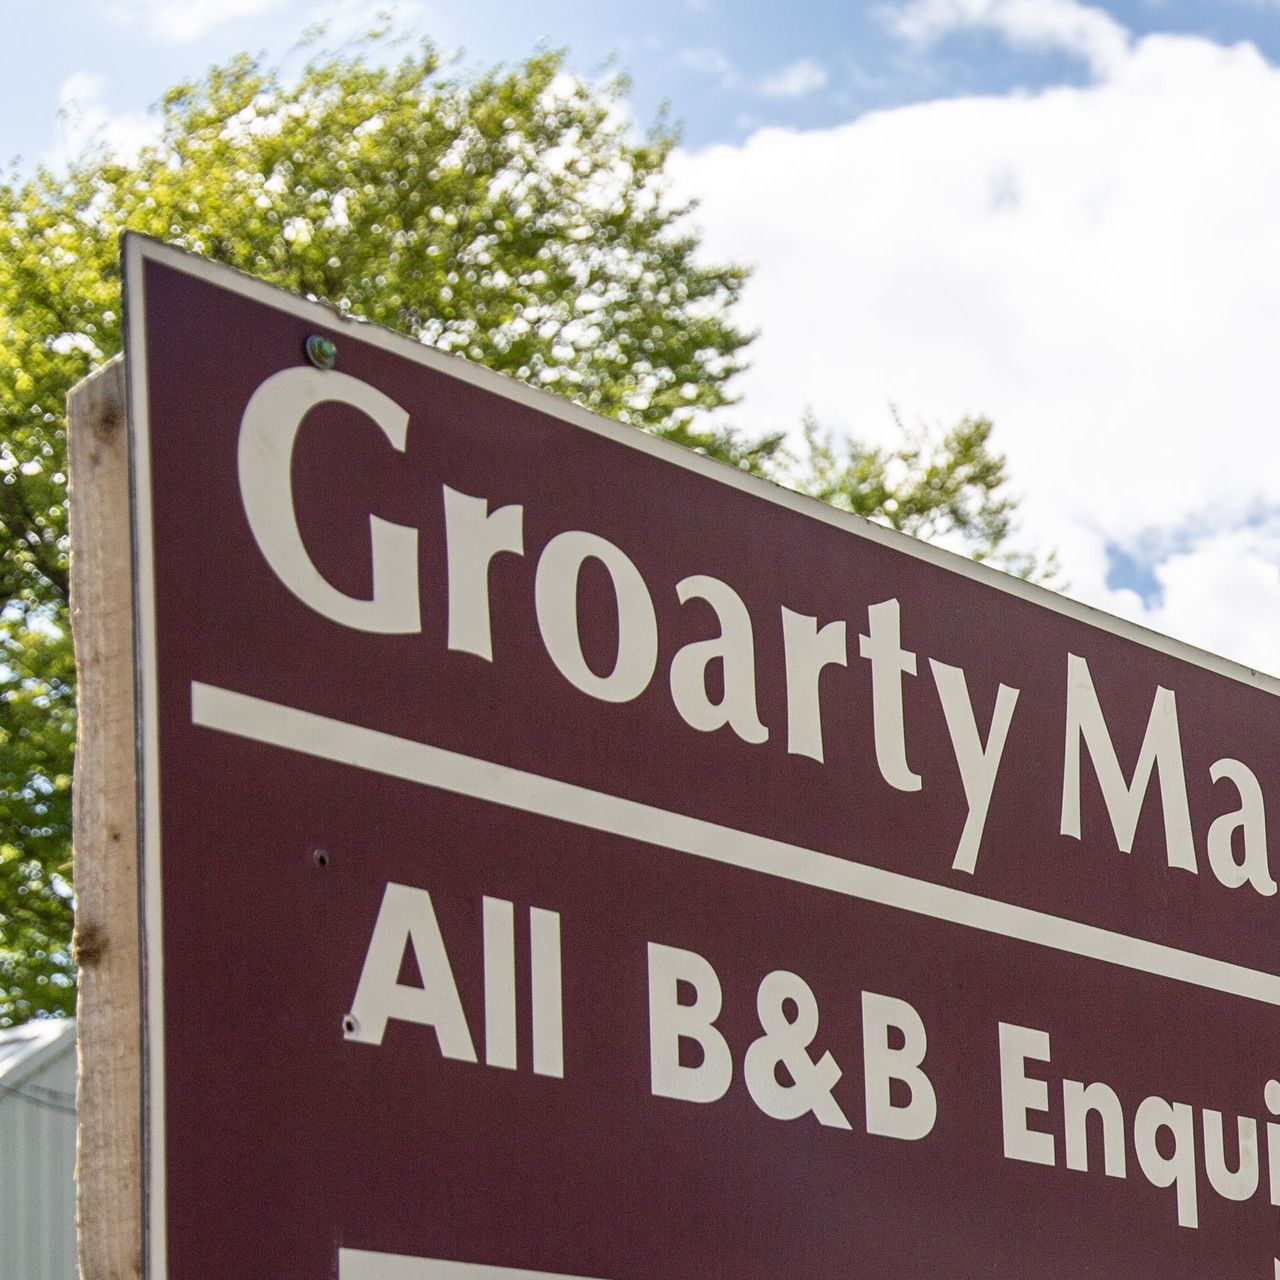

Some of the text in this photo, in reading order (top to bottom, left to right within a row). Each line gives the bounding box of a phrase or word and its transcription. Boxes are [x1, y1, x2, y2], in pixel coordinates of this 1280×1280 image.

[236, 365, 1022, 877] Groarty
[341, 880, 565, 1080] All
[646, 940, 938, 1142] B&B
